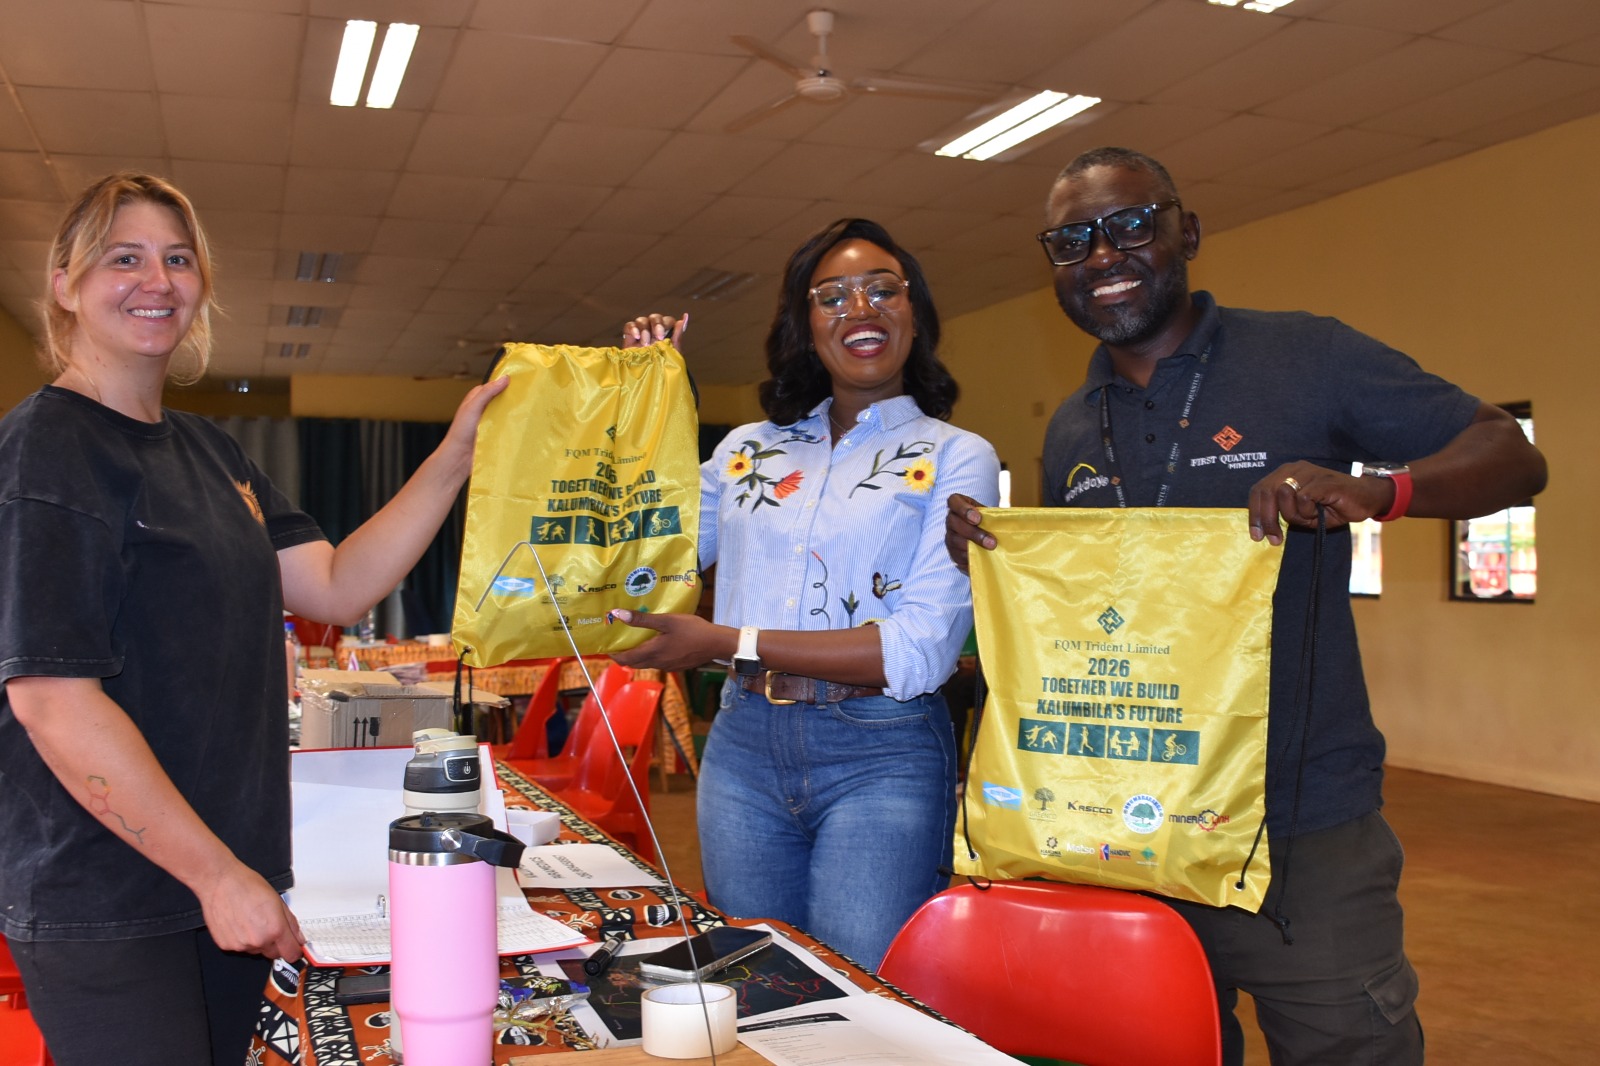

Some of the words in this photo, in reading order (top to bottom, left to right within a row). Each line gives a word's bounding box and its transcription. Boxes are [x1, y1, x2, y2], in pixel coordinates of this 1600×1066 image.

[565, 449, 591, 459] FQM
[1190, 456, 1217, 467] FIRST
[1219, 452, 1267, 464] QUANTUM
[1229, 461, 1265, 469] MINERALS
[596, 461, 618, 484] 206
[578, 617, 602, 625] Metso
[1054, 640, 1080, 651] FQM
[1085, 641, 1124, 652] Trident
[1127, 643, 1170, 654] Limited
[1087, 658, 1130, 677] 2026
[1041, 677, 1106, 696] TOGETHER
[1110, 681, 1133, 697] WE
[1137, 682, 1180, 700] BUILD
[1037, 699, 1126, 720] KALUMBILA'S
[1129, 705, 1183, 723] FUTURE
[1066, 843, 1095, 855] Metso
